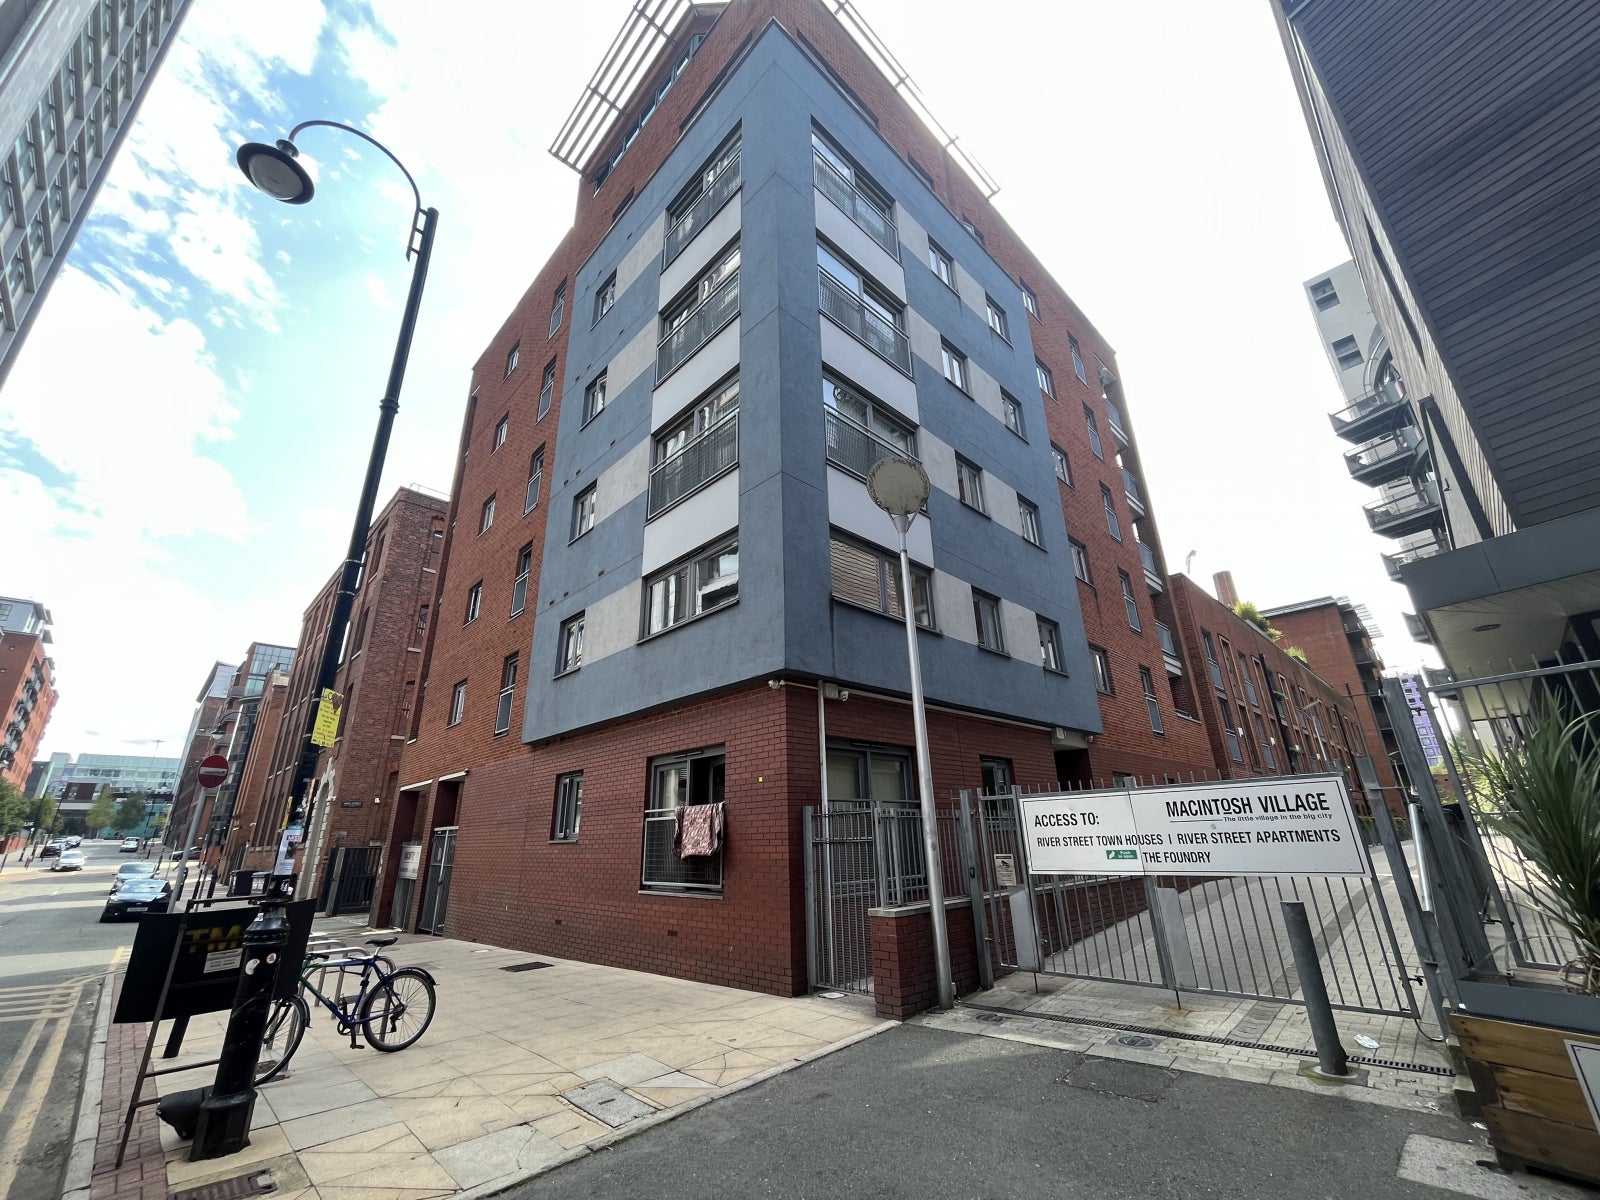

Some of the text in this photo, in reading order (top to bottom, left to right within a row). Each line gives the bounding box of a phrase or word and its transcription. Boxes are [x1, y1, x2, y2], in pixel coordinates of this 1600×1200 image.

[1165, 792, 1330, 817] MACINTOSH VILLAGE
[1034, 812, 1100, 827] ACCESS TO:
[1317, 812, 1333, 820] city
[1036, 836, 1061, 848] RIVER
[1062, 835, 1094, 847] STREET
[1095, 835, 1124, 847] TOWN
[1124, 833, 1164, 846] HOUSES
[1176, 832, 1209, 845] RIVER
[1210, 831, 1252, 844] STREET
[1256, 829, 1341, 843] APARTMENTS
[1142, 851, 1211, 863] THE FOUNDRY
